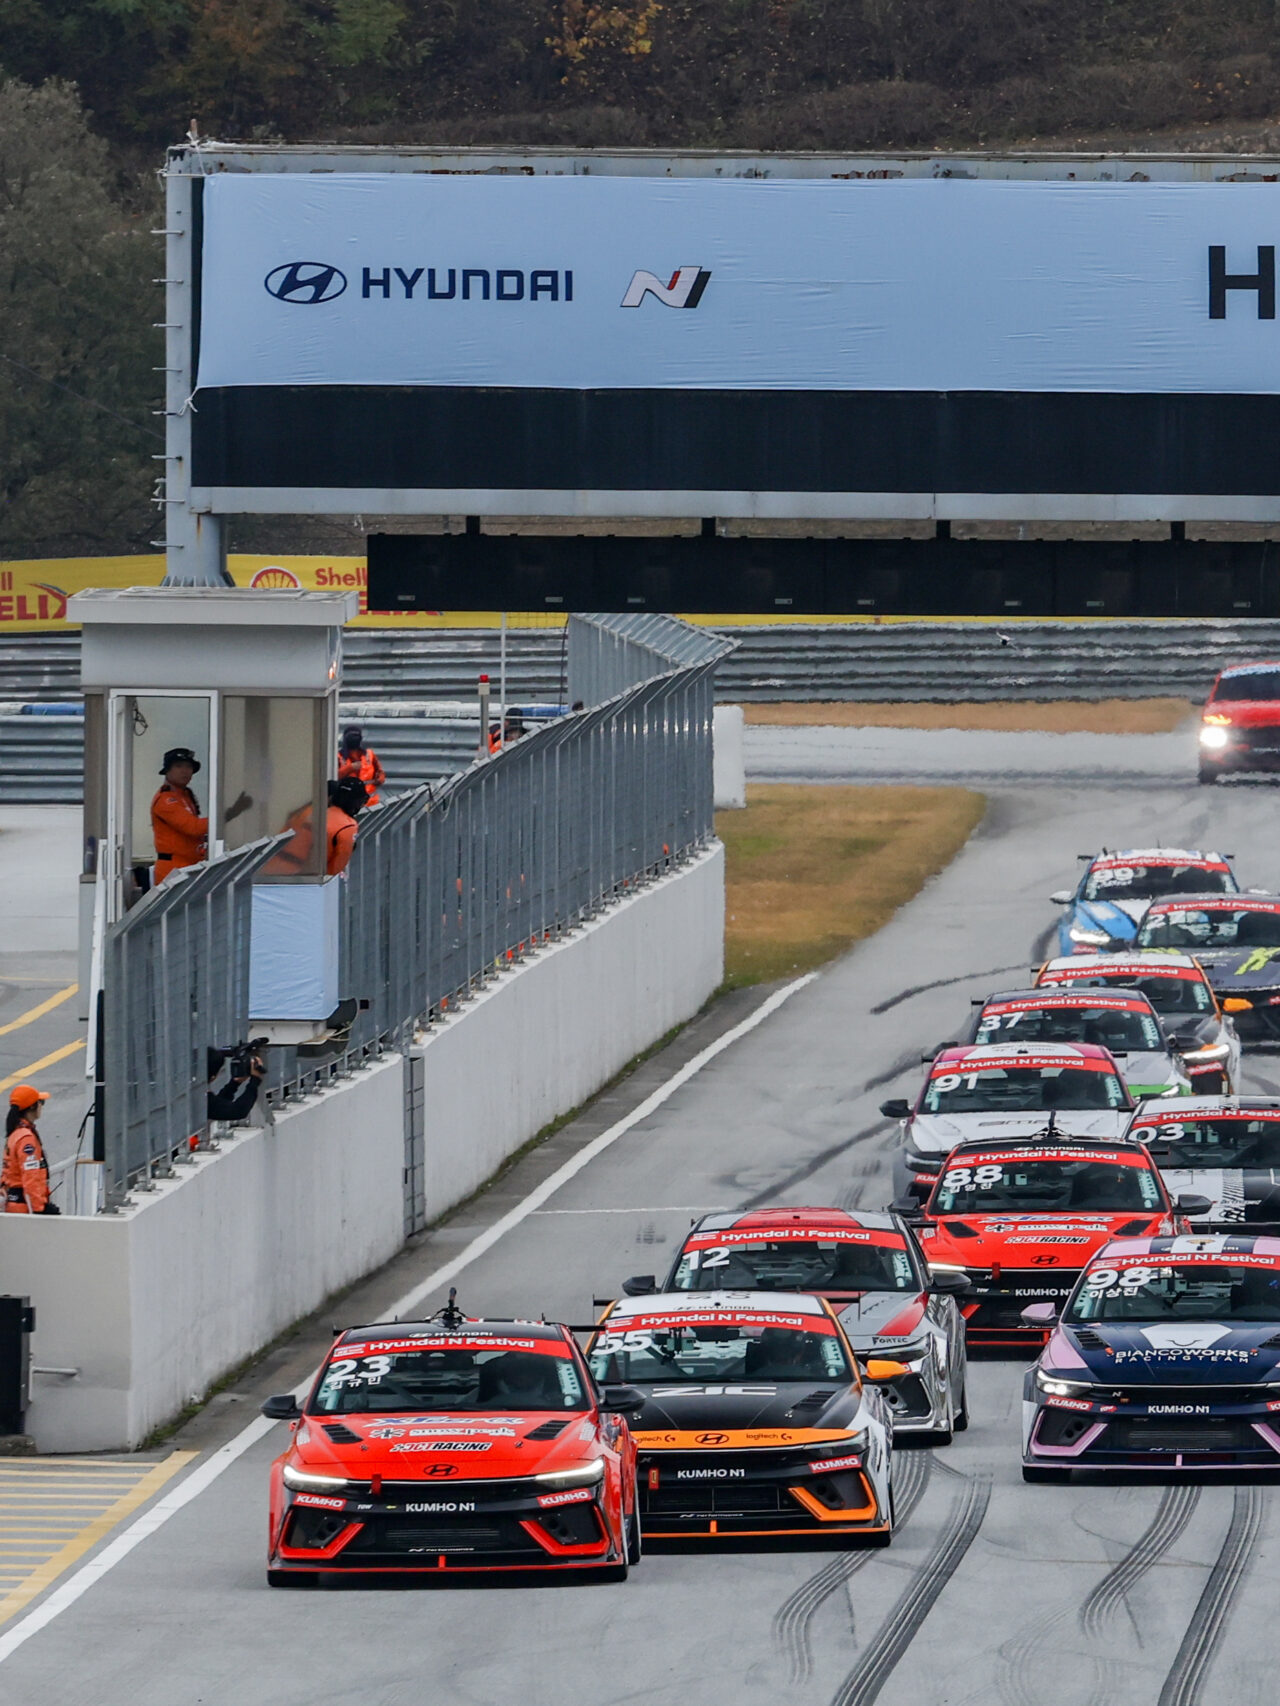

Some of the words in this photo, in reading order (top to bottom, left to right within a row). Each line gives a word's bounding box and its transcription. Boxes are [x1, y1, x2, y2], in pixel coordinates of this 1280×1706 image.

[362, 267, 573, 301] HYUNDAI
[315, 567, 367, 586] Shell
[0, 595, 67, 620] ELI
[978, 1012, 1024, 1032] 37
[960, 1059, 1017, 1069] Hyundai
[934, 1072, 979, 1092] 91
[1163, 1110, 1224, 1120] Hyundai
[1128, 1123, 1186, 1144] 03
[979, 1150, 1042, 1162] Hyundai
[1044, 1150, 1058, 1158] N
[1060, 1150, 1118, 1160] Festival
[942, 1165, 1003, 1188] 88
[721, 1230, 790, 1242] Hyundai
[792, 1230, 806, 1238] N
[808, 1230, 870, 1241] Festival
[682, 1247, 731, 1270] 12
[1121, 1254, 1191, 1266] Hyundai
[1211, 1254, 1275, 1265] Festival
[1086, 1266, 1152, 1290] 98
[1015, 1289, 1058, 1297] KUMHO
[1089, 1287, 1139, 1299] 이상진
[641, 1313, 715, 1325] Hyundai
[718, 1313, 733, 1321] N
[735, 1313, 803, 1325] Festival
[370, 1337, 445, 1351] Hyundai
[448, 1337, 463, 1345] N
[465, 1337, 535, 1348] Festival
[591, 1330, 653, 1355] 55
[1115, 1349, 1249, 1359] BIANCOWORKS
[325, 1355, 391, 1384] 23
[651, 1386, 777, 1397] ZIC
[1048, 1397, 1089, 1410] KUMHO
[1148, 1405, 1193, 1414] KUMHO
[1195, 1405, 1210, 1414] N1
[811, 1457, 859, 1471] KUMHO
[677, 1469, 727, 1479] KUMHO
[729, 1468, 745, 1478] N1
[296, 1494, 343, 1508] KUMHO
[541, 1491, 588, 1505] KUMHO
[406, 1503, 457, 1512] KUMHO
[459, 1502, 475, 1511] N1
